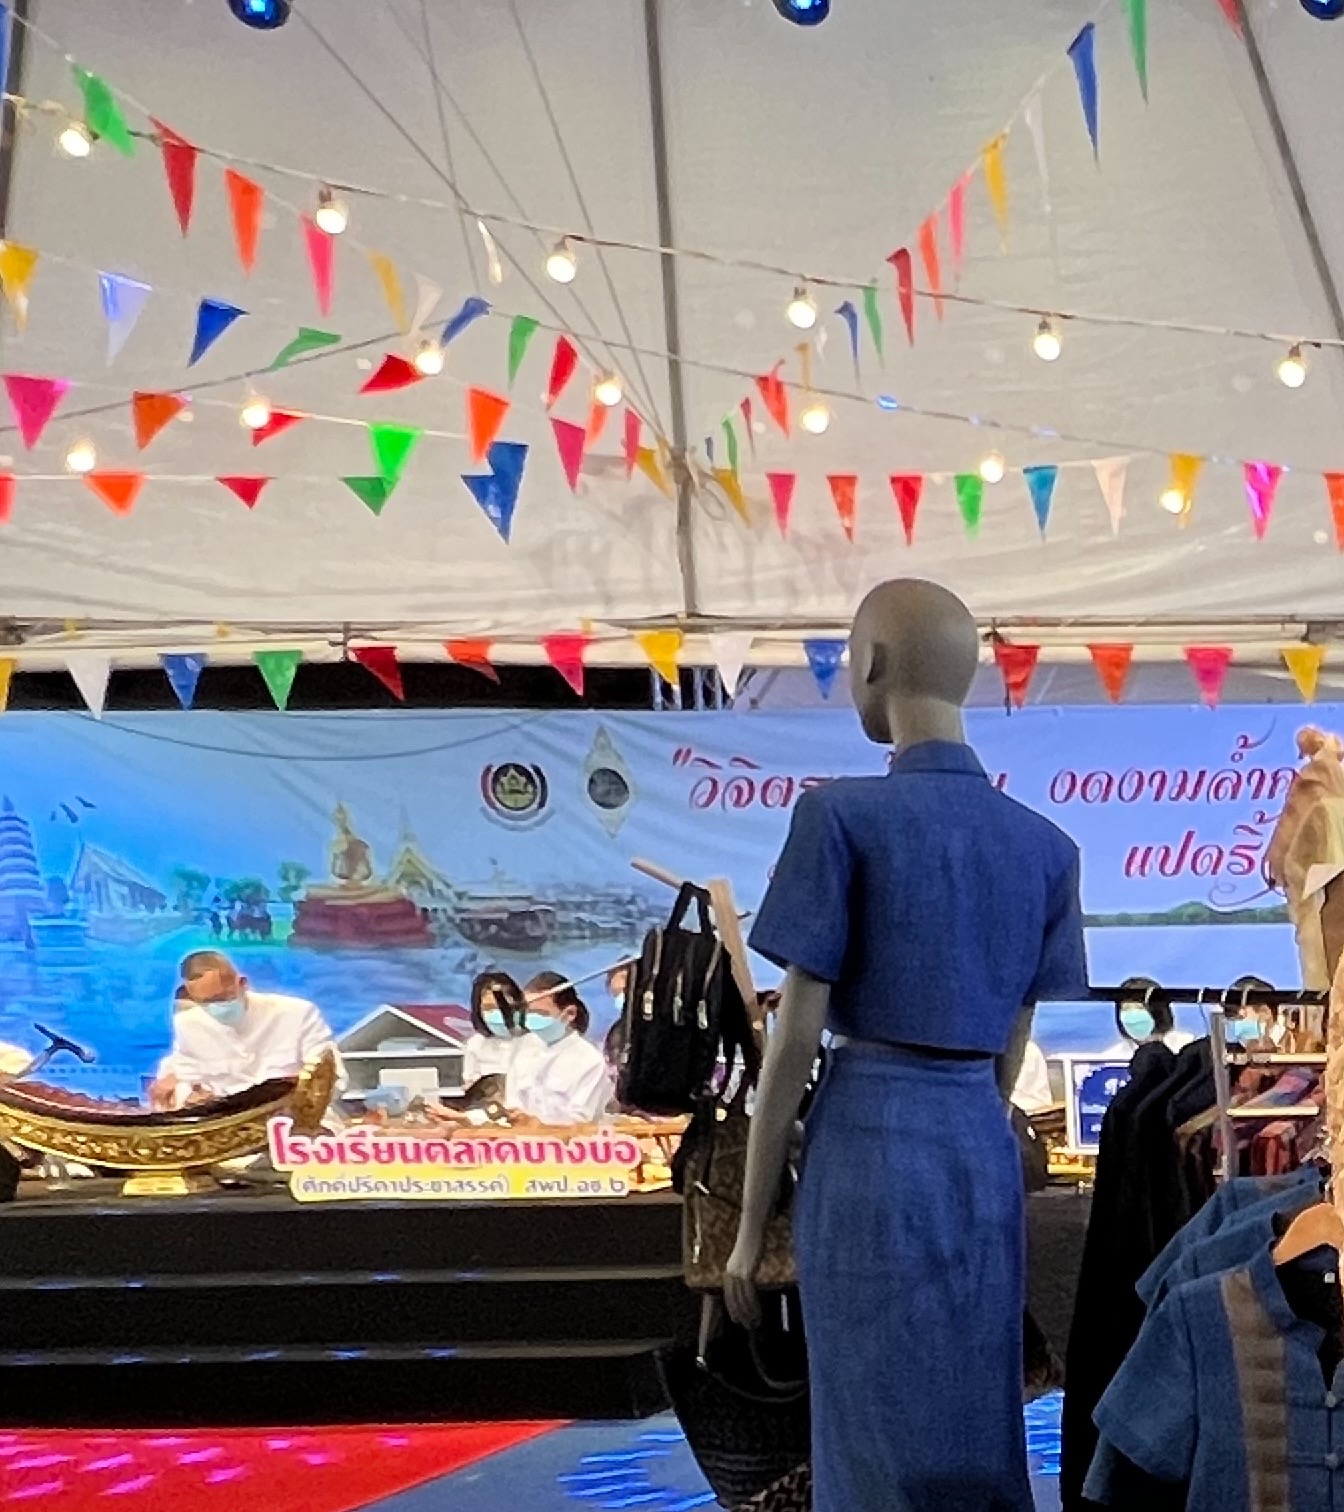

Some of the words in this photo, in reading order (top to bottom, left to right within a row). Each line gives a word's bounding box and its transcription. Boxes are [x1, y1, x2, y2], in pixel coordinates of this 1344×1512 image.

[272, 1121, 638, 1165] โรงเรียนตลาดบางบ่อ
